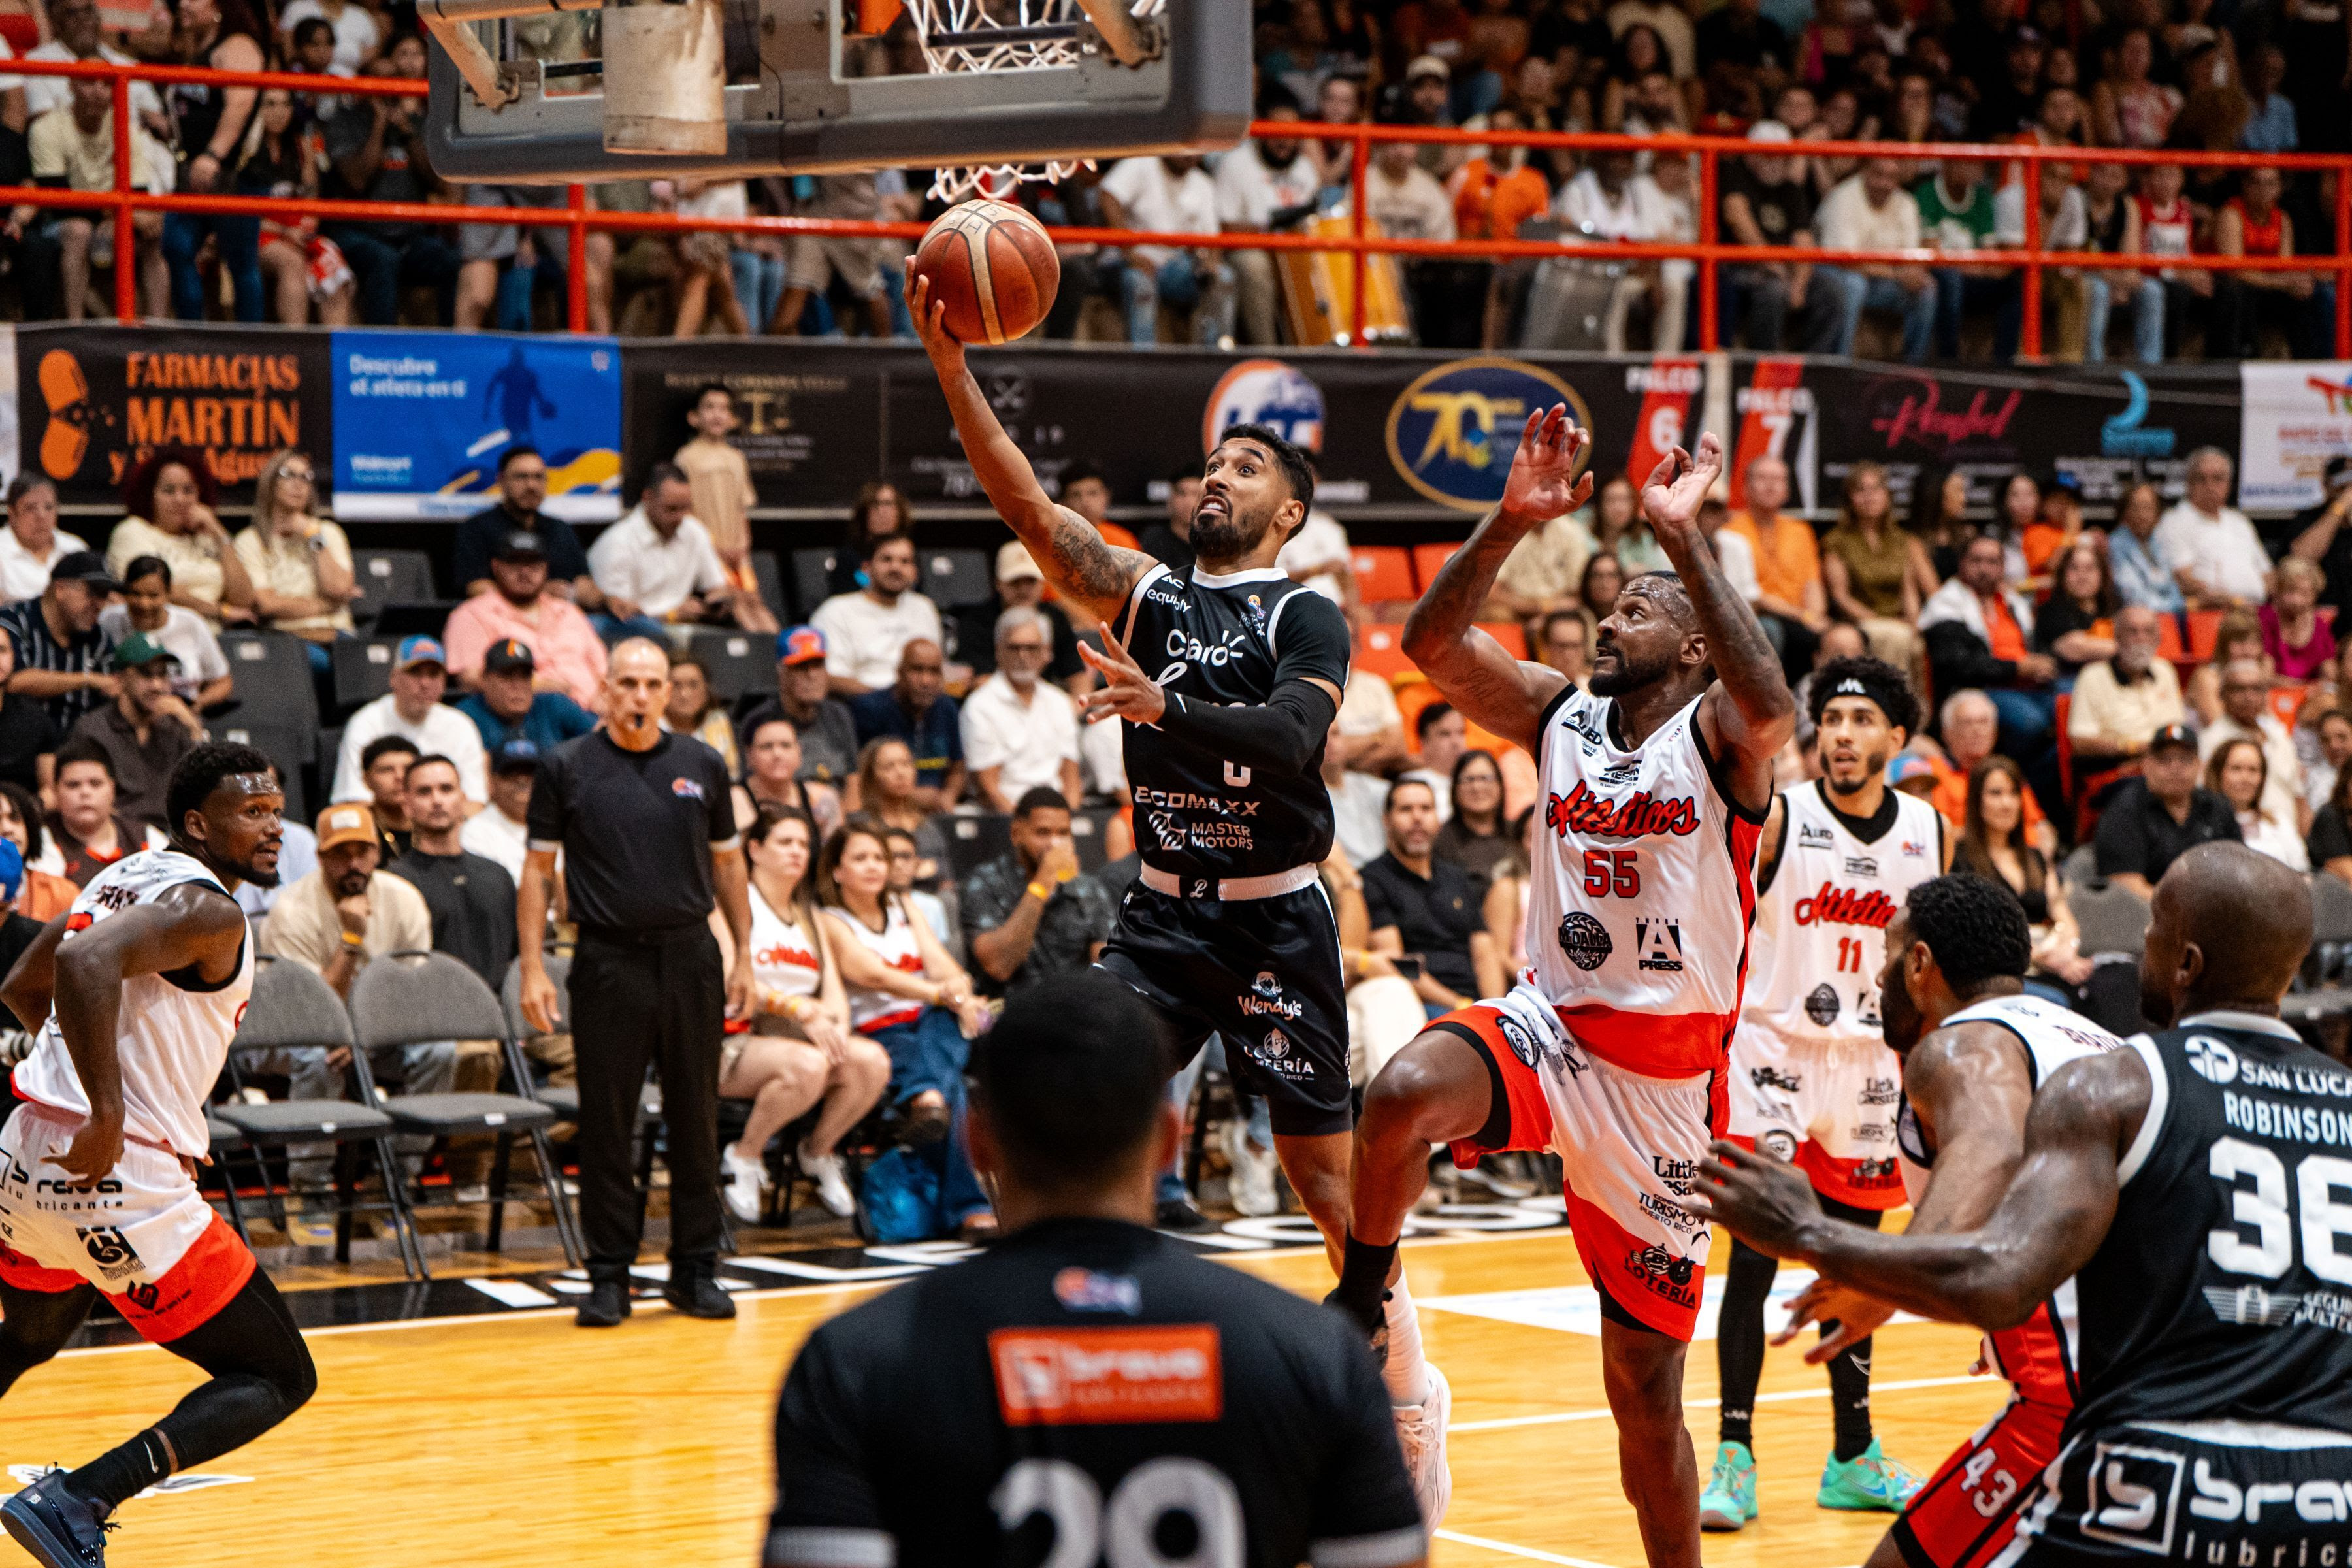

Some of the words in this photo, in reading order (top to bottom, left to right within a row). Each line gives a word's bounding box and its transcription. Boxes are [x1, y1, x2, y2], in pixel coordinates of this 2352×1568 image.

[127, 353, 301, 391] FARMACIAS
[127, 392, 301, 447] MARTÍN
[1648, 406, 1684, 457] 6
[1760, 414, 1794, 460] 7
[1166, 629, 1230, 667] Claro
[1135, 785, 1260, 817] ECOMAXX
[1190, 836, 1254, 851] MOTORS
[1191, 822, 1251, 838] MASTER
[1583, 850, 1641, 898] 55
[1639, 959, 1684, 972] PRESS
[1837, 936, 1863, 973] 11
[1237, 995, 1302, 1020] Wendy's
[2240, 1058, 2291, 1091] SAN
[2223, 1090, 2352, 1147] ROBINSON
[1653, 1155, 1699, 1179] Little
[1639, 1191, 1696, 1226] TURISMO
[1640, 1205, 1671, 1226] PUERTO
[1674, 1222, 1692, 1234] RICO
[1624, 1256, 1696, 1305] LOTERÍA
[1959, 1446, 2017, 1518] 43
[2189, 1458, 2352, 1524] bra
